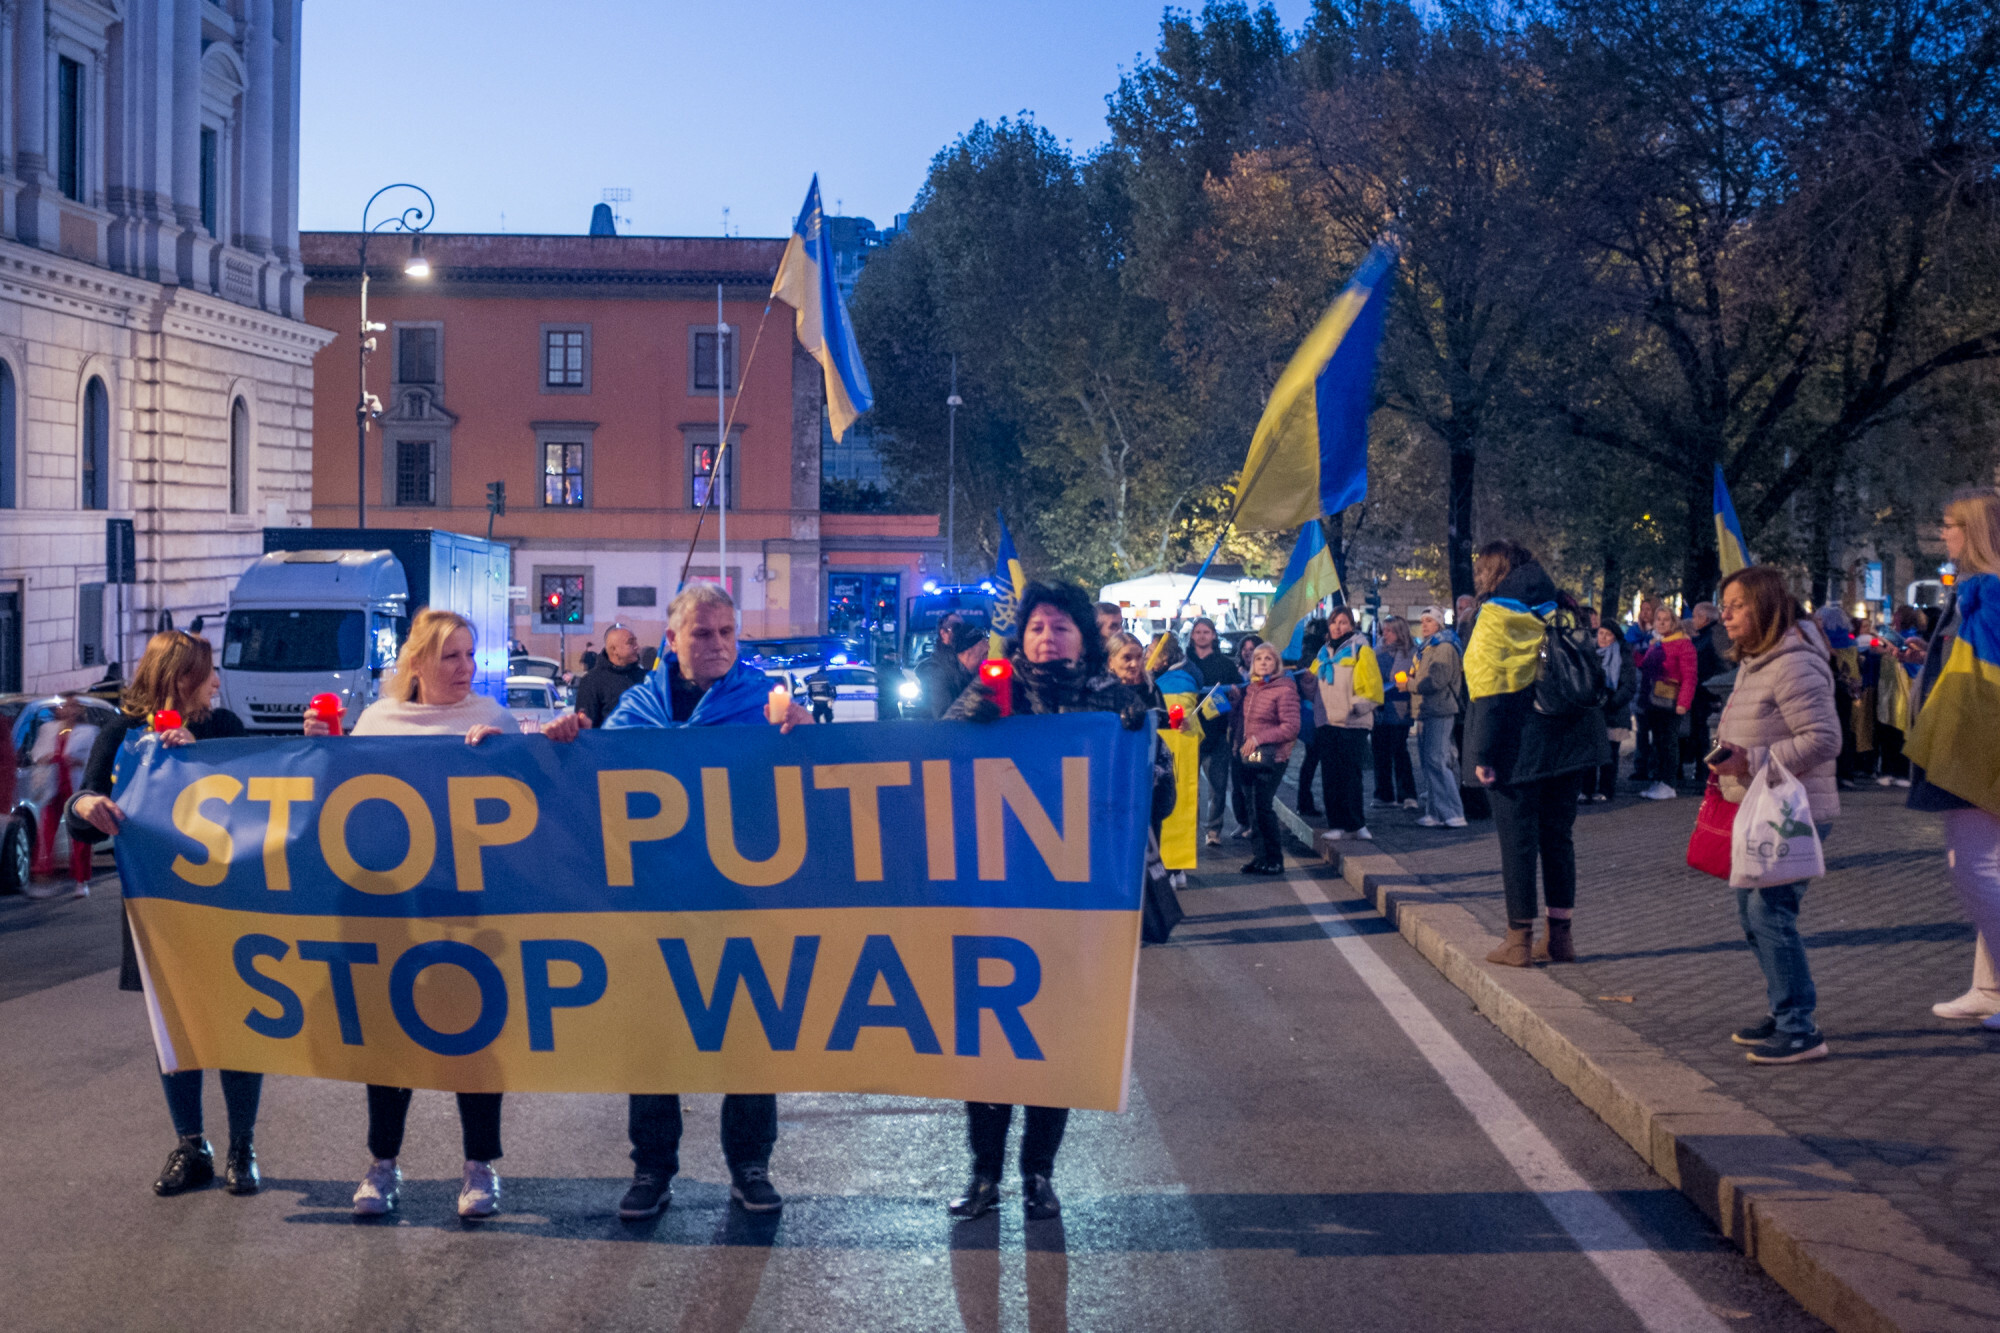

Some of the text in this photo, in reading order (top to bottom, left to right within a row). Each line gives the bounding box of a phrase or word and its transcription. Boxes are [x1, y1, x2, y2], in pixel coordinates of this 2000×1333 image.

[170, 758, 1089, 896] STOP PUTIN
[1746, 839, 1790, 858] ECO
[231, 933, 1046, 1061] STOP WAR
